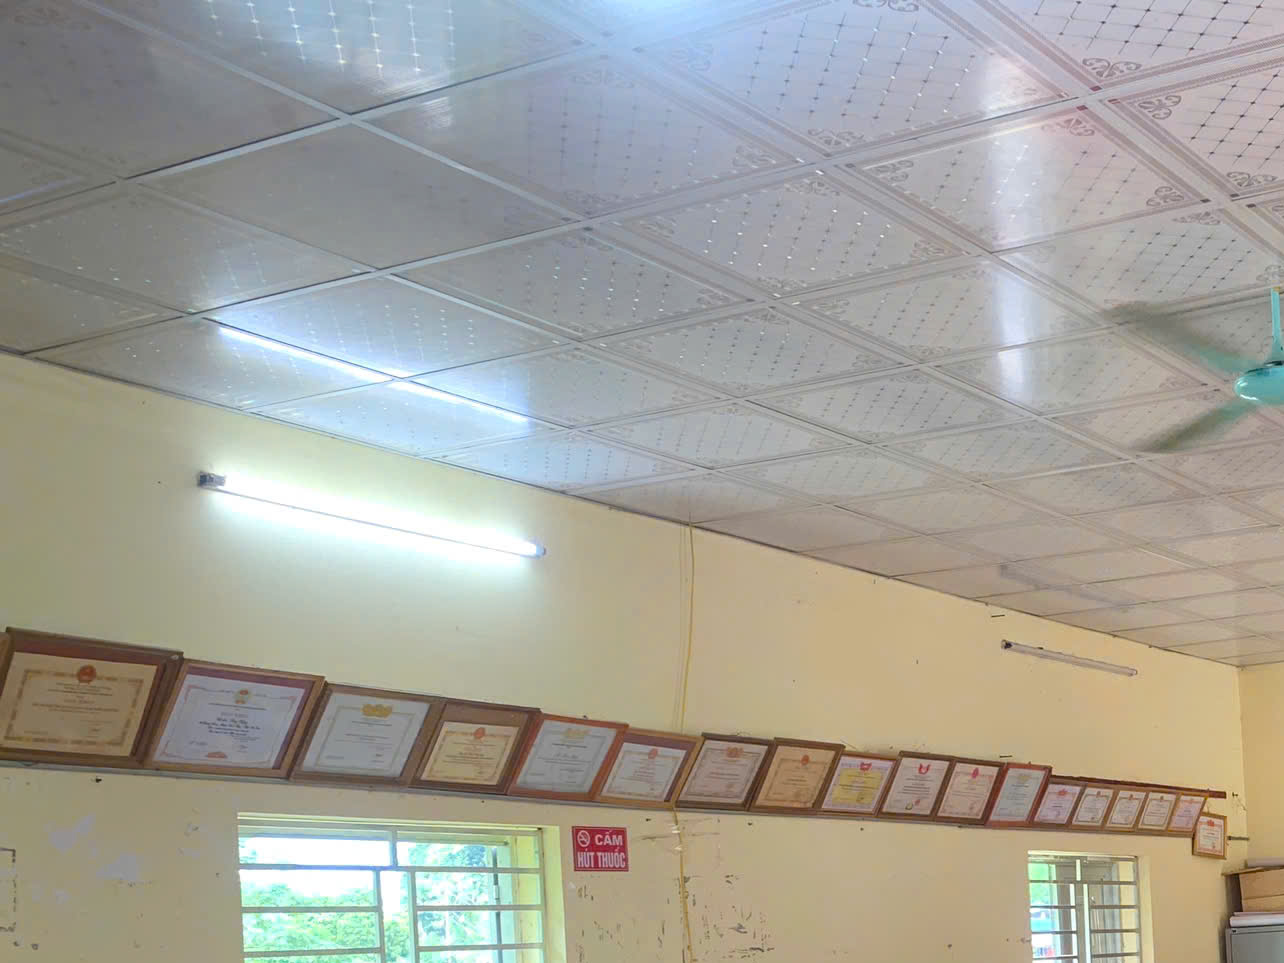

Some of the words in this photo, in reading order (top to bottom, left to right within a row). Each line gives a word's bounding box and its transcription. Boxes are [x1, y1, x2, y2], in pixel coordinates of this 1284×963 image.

[595, 830, 623, 846] CẤM
[577, 848, 595, 868] HÚT
[596, 847, 626, 868] THUỐC
